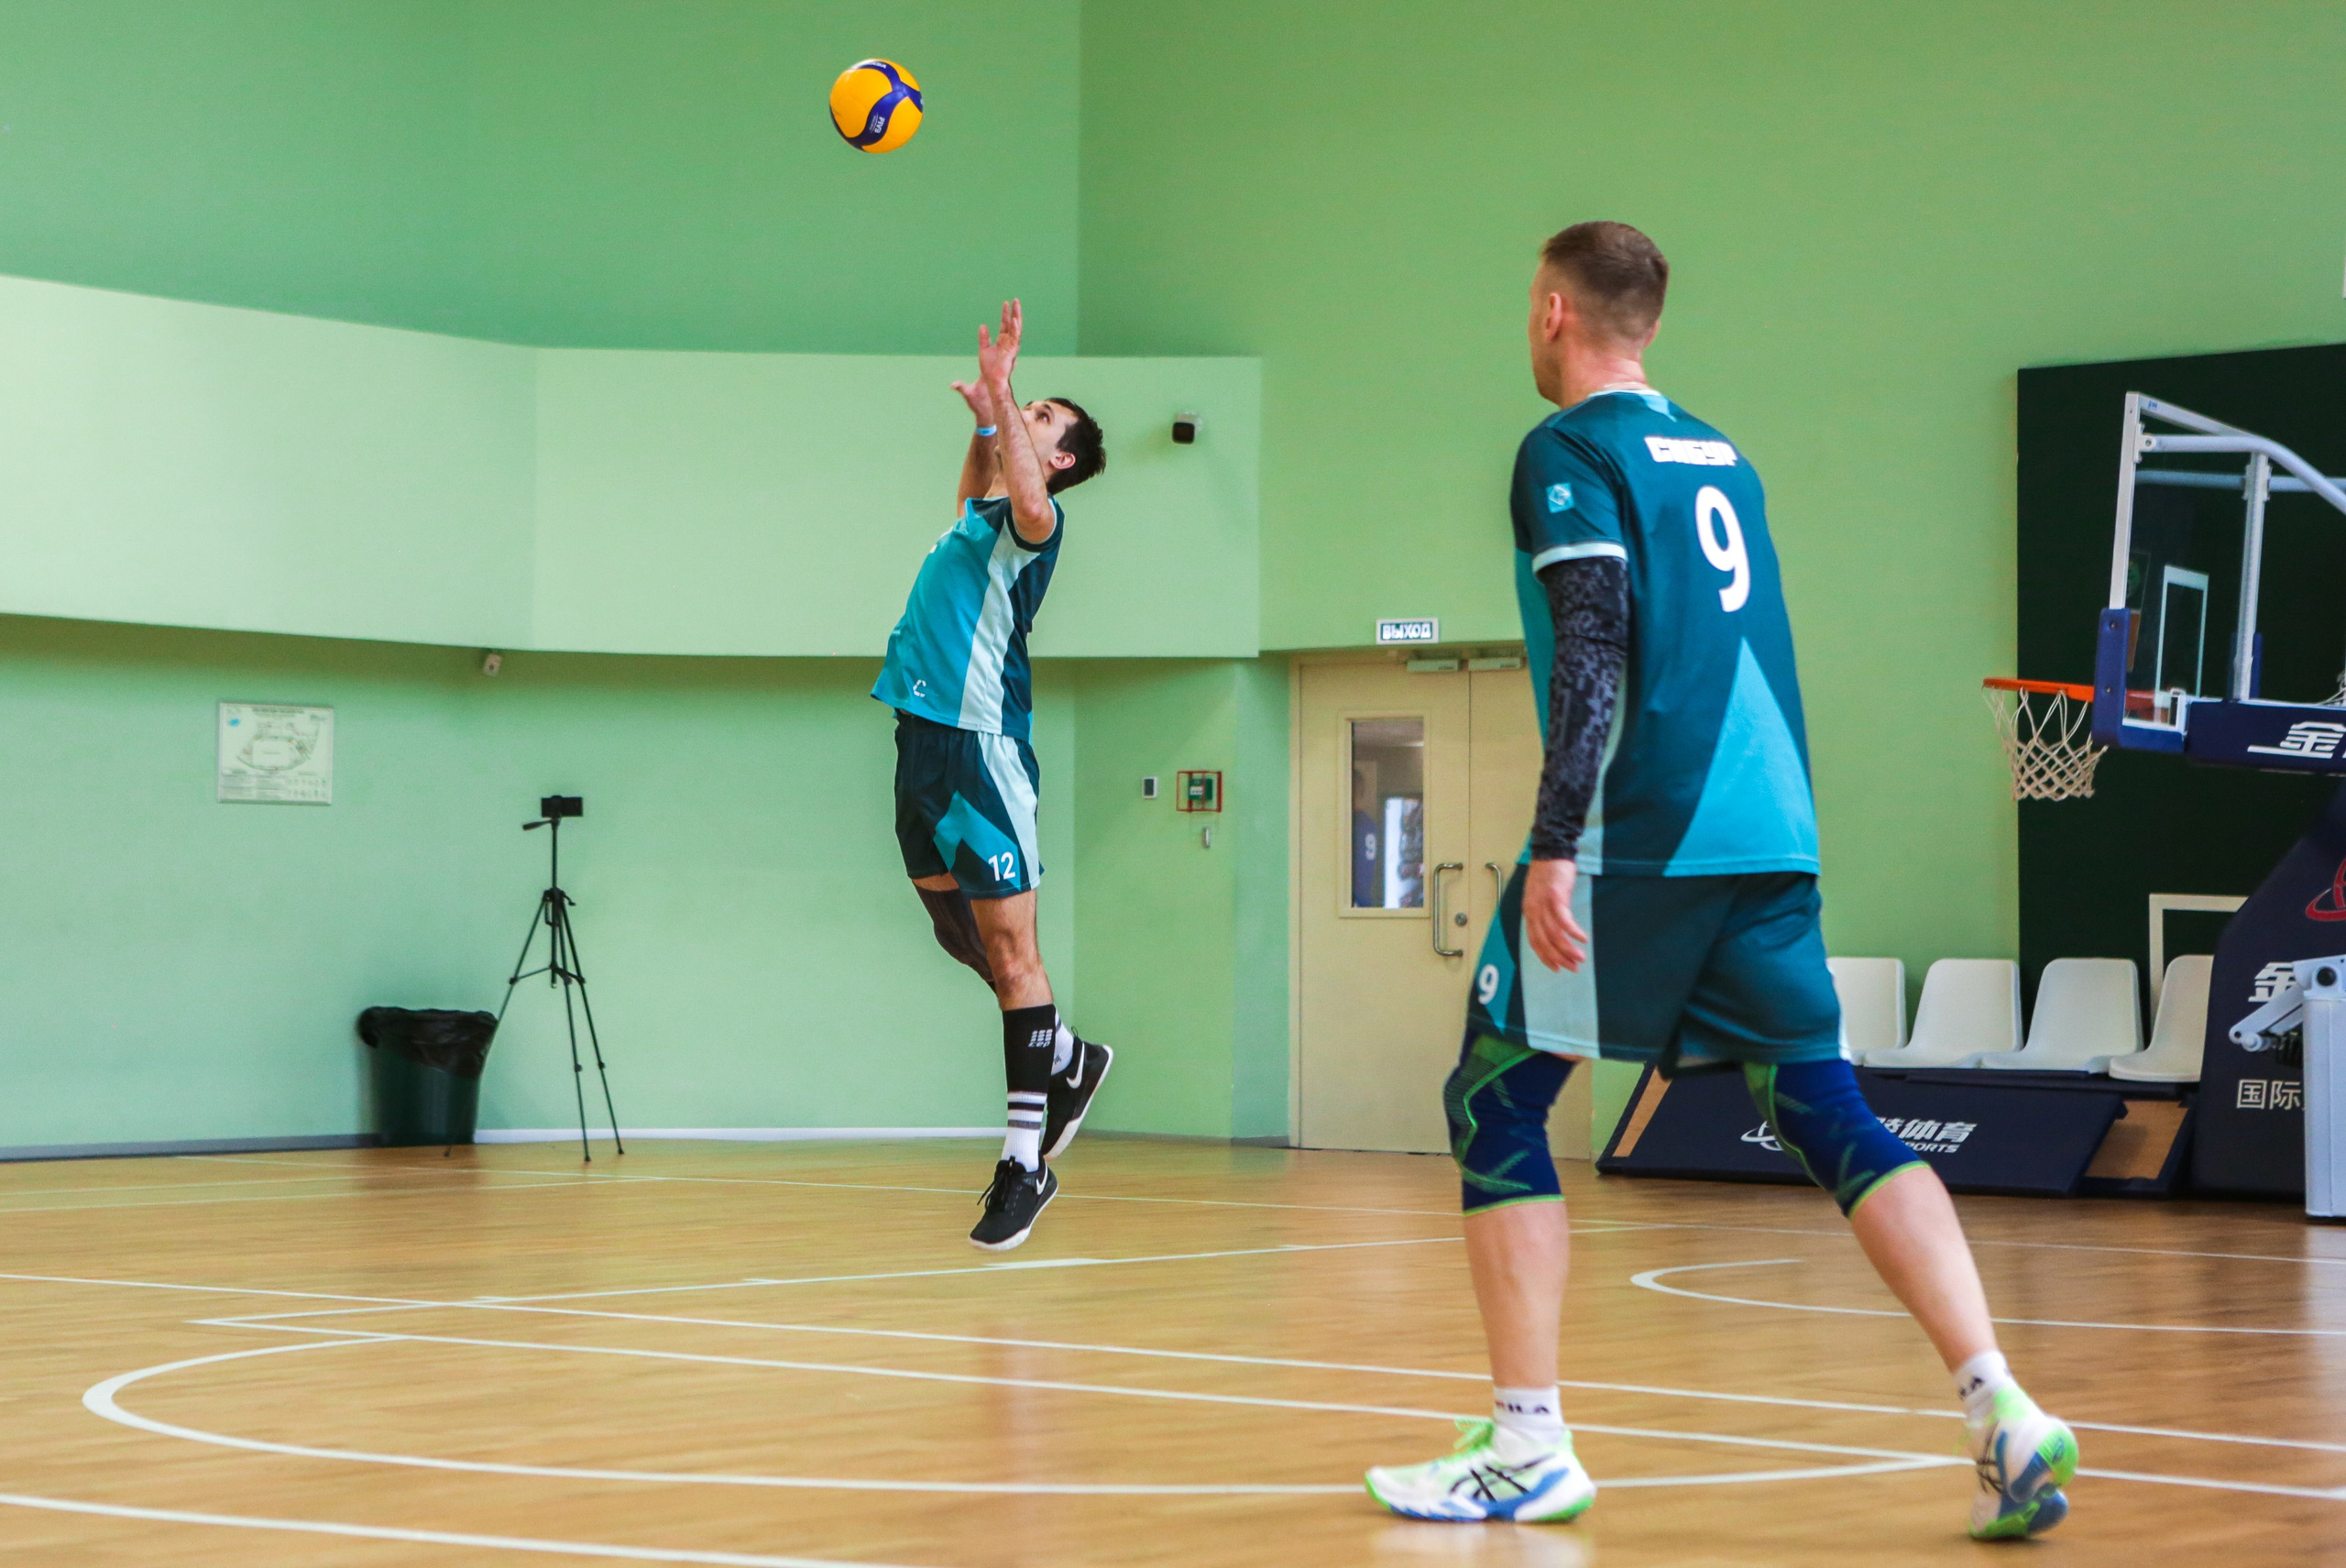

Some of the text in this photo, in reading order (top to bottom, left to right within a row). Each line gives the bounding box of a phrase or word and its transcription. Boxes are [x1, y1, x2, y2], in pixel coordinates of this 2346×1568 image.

[1695, 485, 1750, 613] 9
[1382, 623, 1431, 640] ВЫХОД
[988, 851, 1016, 882] 12
[1478, 964, 1499, 1004] 9
[2237, 1079, 2305, 1111] 国际
